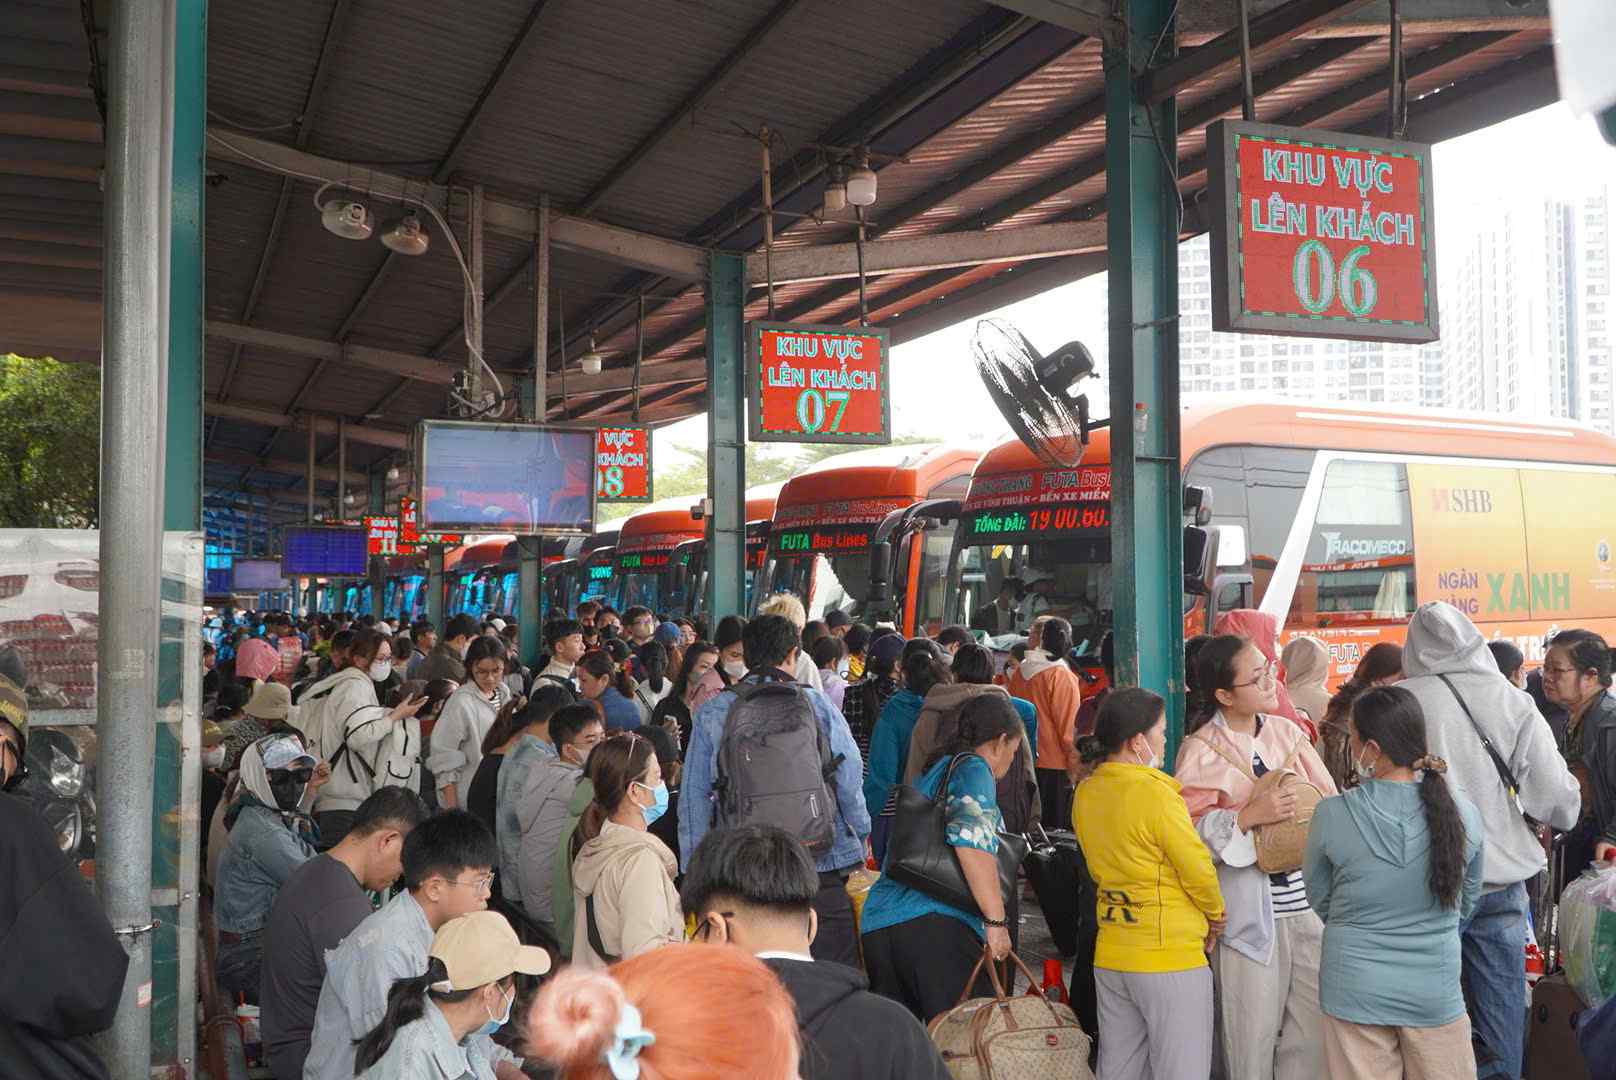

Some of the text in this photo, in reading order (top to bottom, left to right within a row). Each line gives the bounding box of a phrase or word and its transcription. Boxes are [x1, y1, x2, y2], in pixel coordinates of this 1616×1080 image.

[1263, 148, 1393, 197] KHU VỰC
[1251, 192, 1415, 245] LÊN KHÁCH
[1292, 239, 1378, 316] 06
[776, 336, 863, 364] KHU VỰC
[768, 361, 877, 390] LÊN KHÁCH
[796, 388, 851, 433] 07
[598, 466, 624, 496] 8
[1041, 471, 1079, 489] FUTA
[1061, 492, 1078, 501] XE
[1451, 489, 1492, 513] SHB
[780, 533, 810, 550] FUTA
[1486, 571, 1570, 613] XANH
[1327, 643, 1361, 663] FUTA
